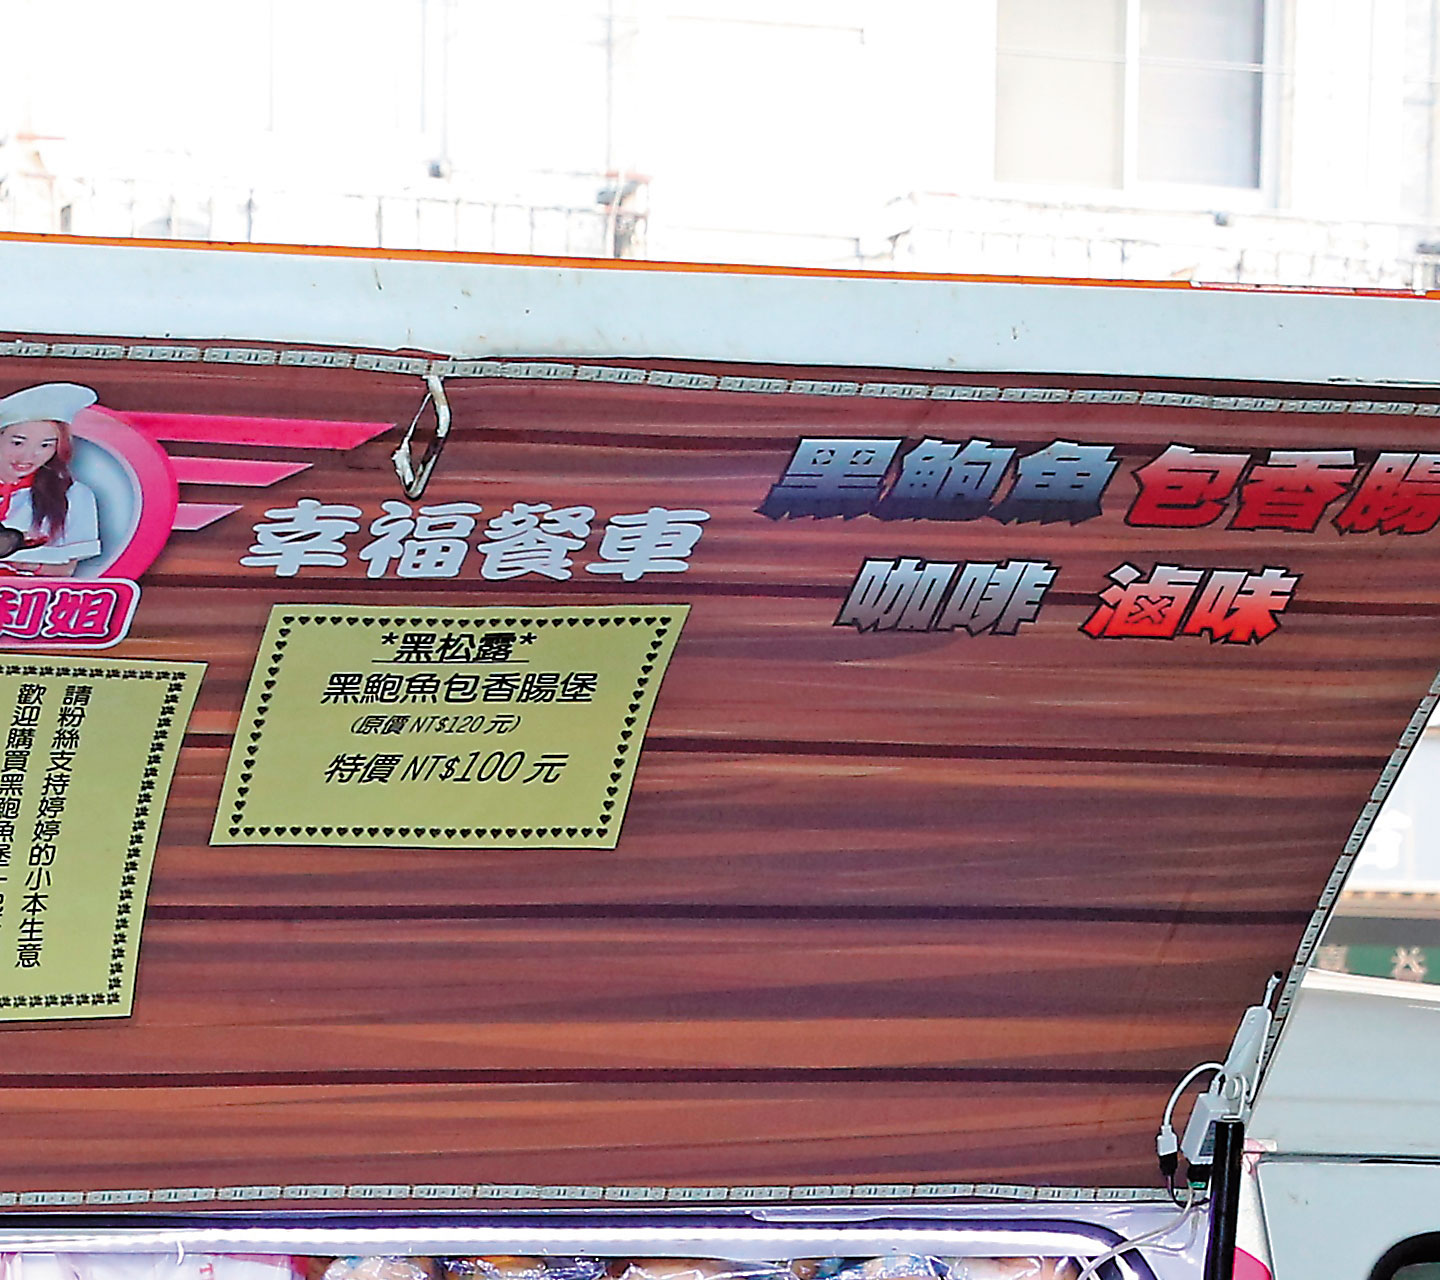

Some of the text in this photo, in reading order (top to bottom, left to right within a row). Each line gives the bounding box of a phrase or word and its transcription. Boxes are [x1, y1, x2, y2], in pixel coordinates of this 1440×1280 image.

[240, 499, 710, 581] 幸福餐車
[831, 556, 1304, 645] 咖啡 滷味
[321, 672, 597, 705] 黑鮑魚包香腸堡
[324, 751, 569, 784] 特價 NT$100 元
[15, 684, 93, 969] 請粉絲支持婷婷的小本生意
